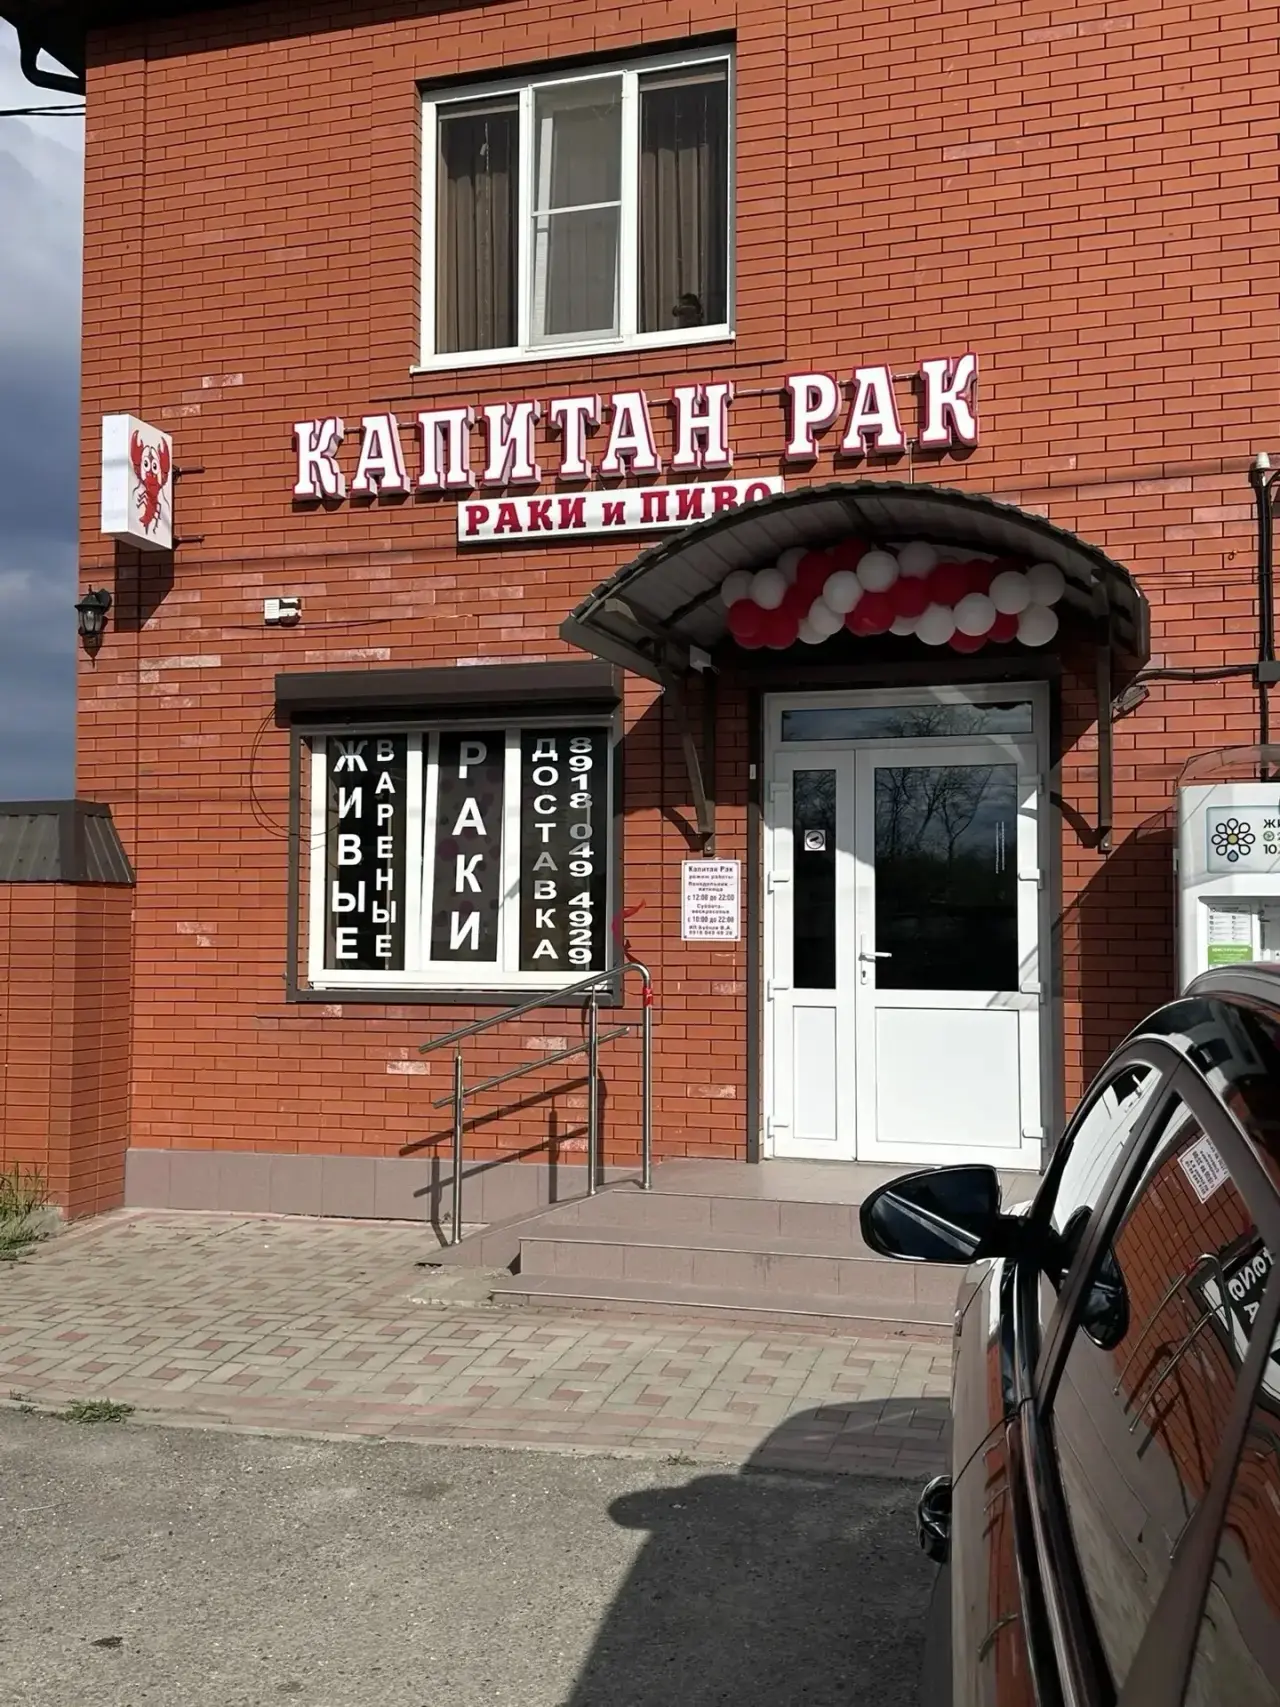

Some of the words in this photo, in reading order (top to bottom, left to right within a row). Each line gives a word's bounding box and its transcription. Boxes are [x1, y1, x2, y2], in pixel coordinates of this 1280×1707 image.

[293, 381, 734, 500] КАПИТАН
[785, 352, 978, 461] РАК
[465, 497, 587, 536] РАКИ
[602, 501, 626, 526] и
[640, 482, 772, 523] ПИВО
[450, 740, 487, 950] РАКИ
[569, 737, 593, 809] 8918
[332, 740, 368, 959] ЖИВЫЕ
[372, 739, 397, 957] ВАРЕНЫЕ
[531, 737, 559, 960] ДОСТАВКА
[568, 823, 594, 878] 049
[568, 892, 594, 965] 4929
